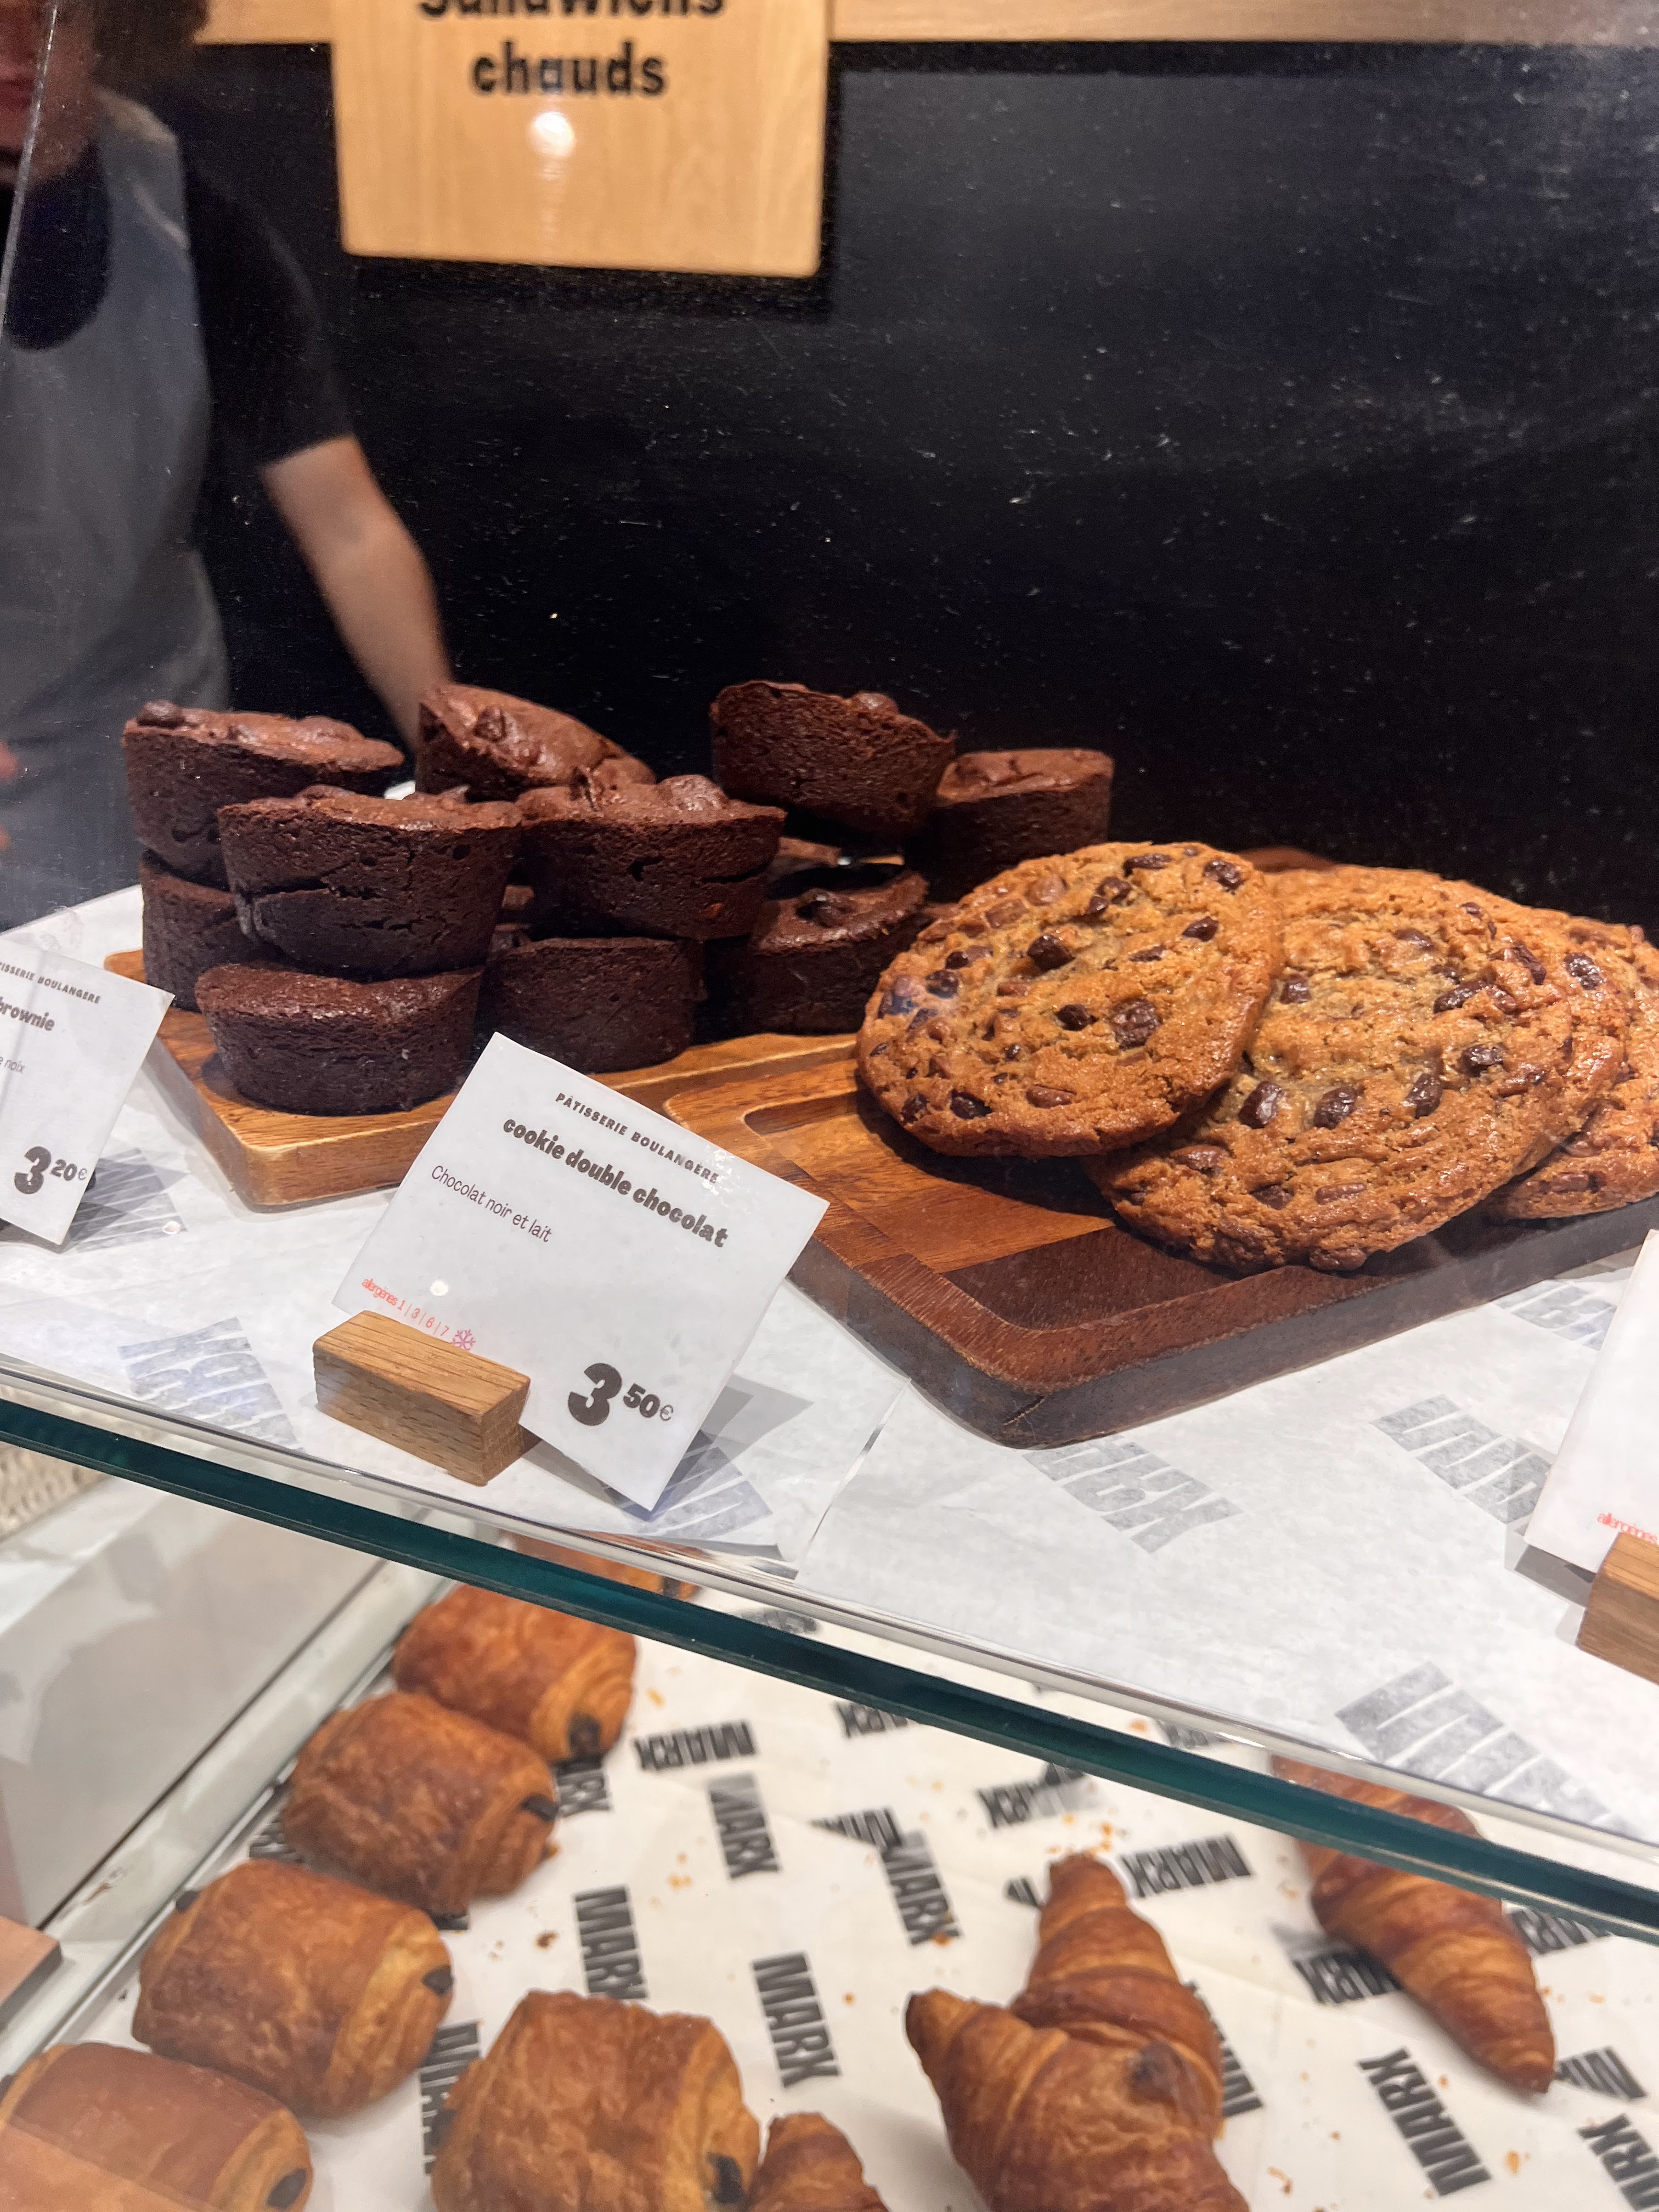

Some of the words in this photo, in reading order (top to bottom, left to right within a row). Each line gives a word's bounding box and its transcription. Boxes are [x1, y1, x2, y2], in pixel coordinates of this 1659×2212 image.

[472, 40, 665, 97] chauds
[431, 1165, 487, 1206] Chocolat
[485, 1199, 512, 1218] noir
[512, 1214, 530, 1229] et
[528, 1219, 552, 1243] lait
[503, 1118, 565, 1160] cookie
[565, 1149, 632, 1196] double
[633, 1187, 729, 1248] chocolat
[634, 1718, 755, 1771] MARX
[1122, 1834, 1253, 1899] MARX
[752, 1950, 842, 2089] MARX
[1357, 2047, 1492, 2197] MARX
